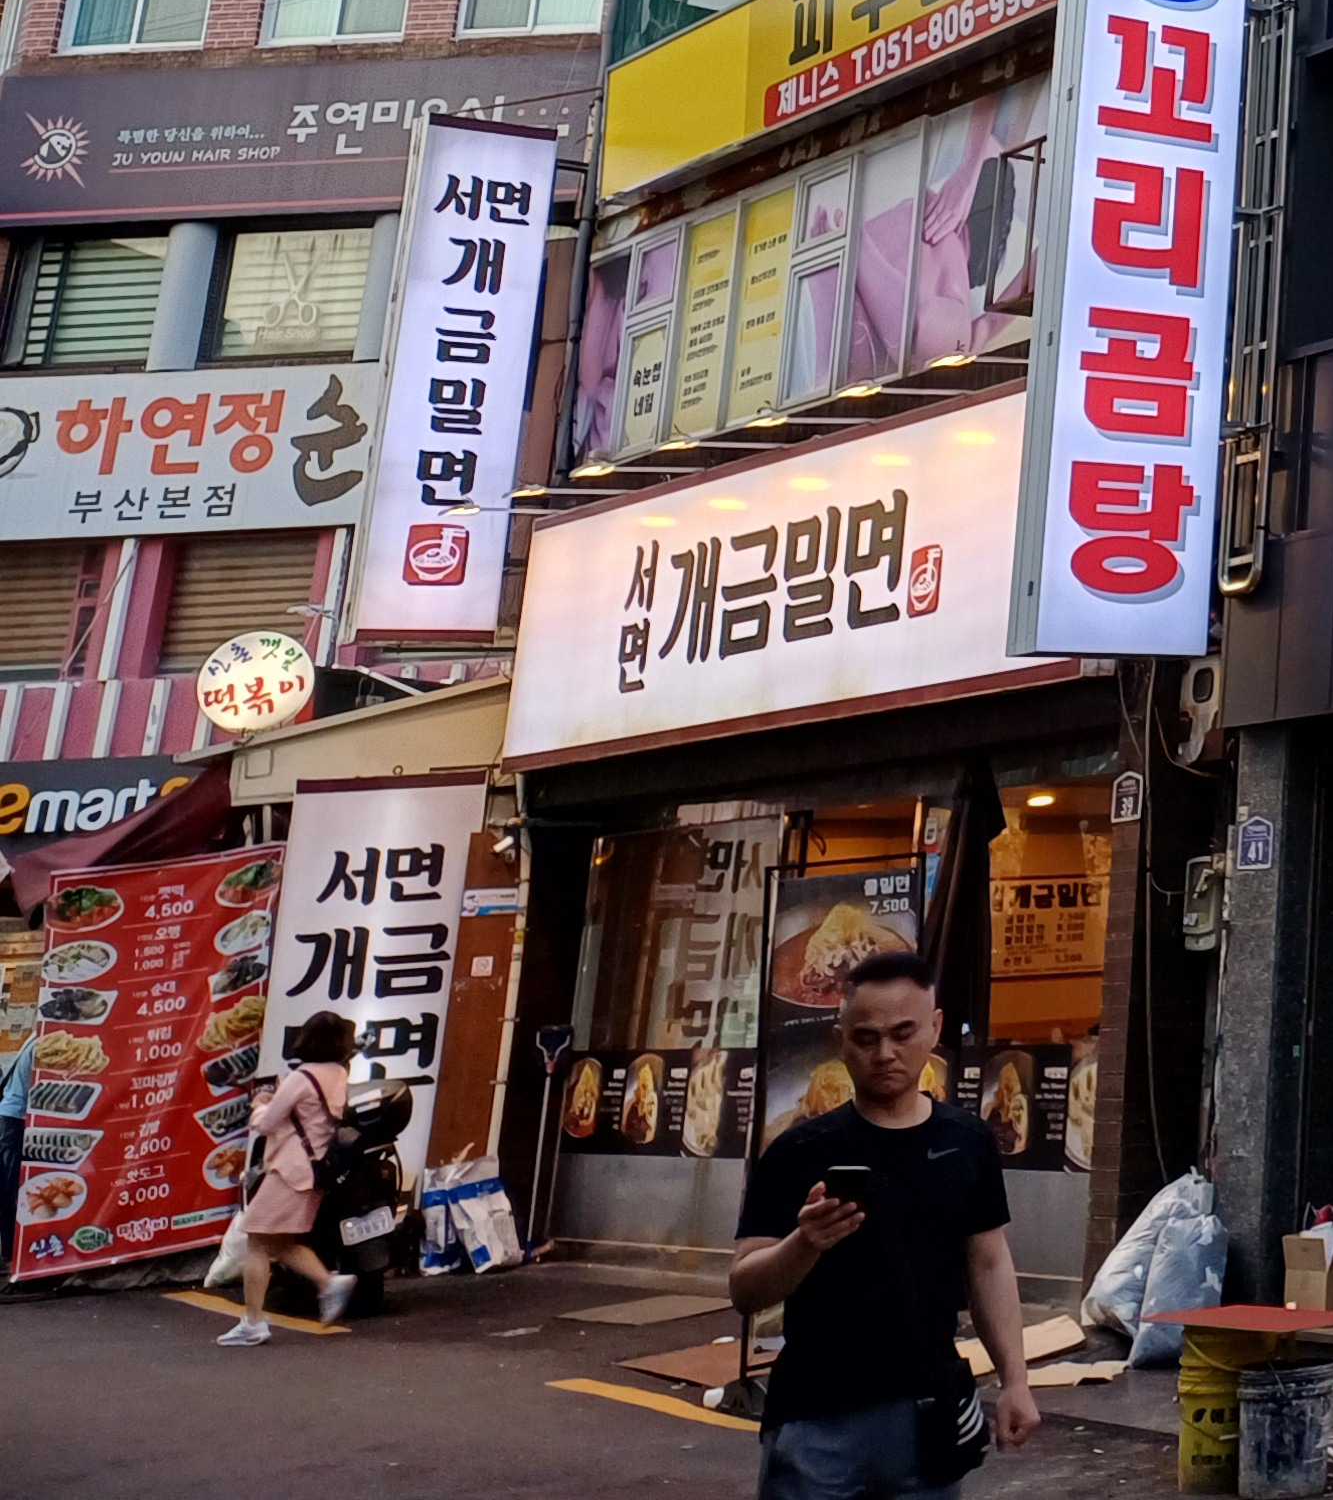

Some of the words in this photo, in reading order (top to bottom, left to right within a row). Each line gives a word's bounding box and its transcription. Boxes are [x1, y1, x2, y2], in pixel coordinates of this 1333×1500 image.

[777, 62, 840, 117] 제니스
[112, 153, 133, 166] JU
[141, 151, 185, 164] YOUN
[192, 148, 230, 162] HAIR
[237, 146, 281, 161] SHOP
[434, 174, 532, 227] 서면
[55, 389, 286, 476] 하연정
[67, 483, 238, 524] 부산본점
[658, 489, 909, 664] 개금밀면
[618, 539, 659, 693] 서면
[203, 676, 306, 716] 떡볶이
[316, 843, 446, 905] 서면
[870, 897, 909, 915] 7,500
[285, 922, 452, 1001] 개금
[137, 996, 187, 1017] 4,500
[136, 1042, 182, 1062] 1,000
[118, 1183, 171, 1207] 3,000
